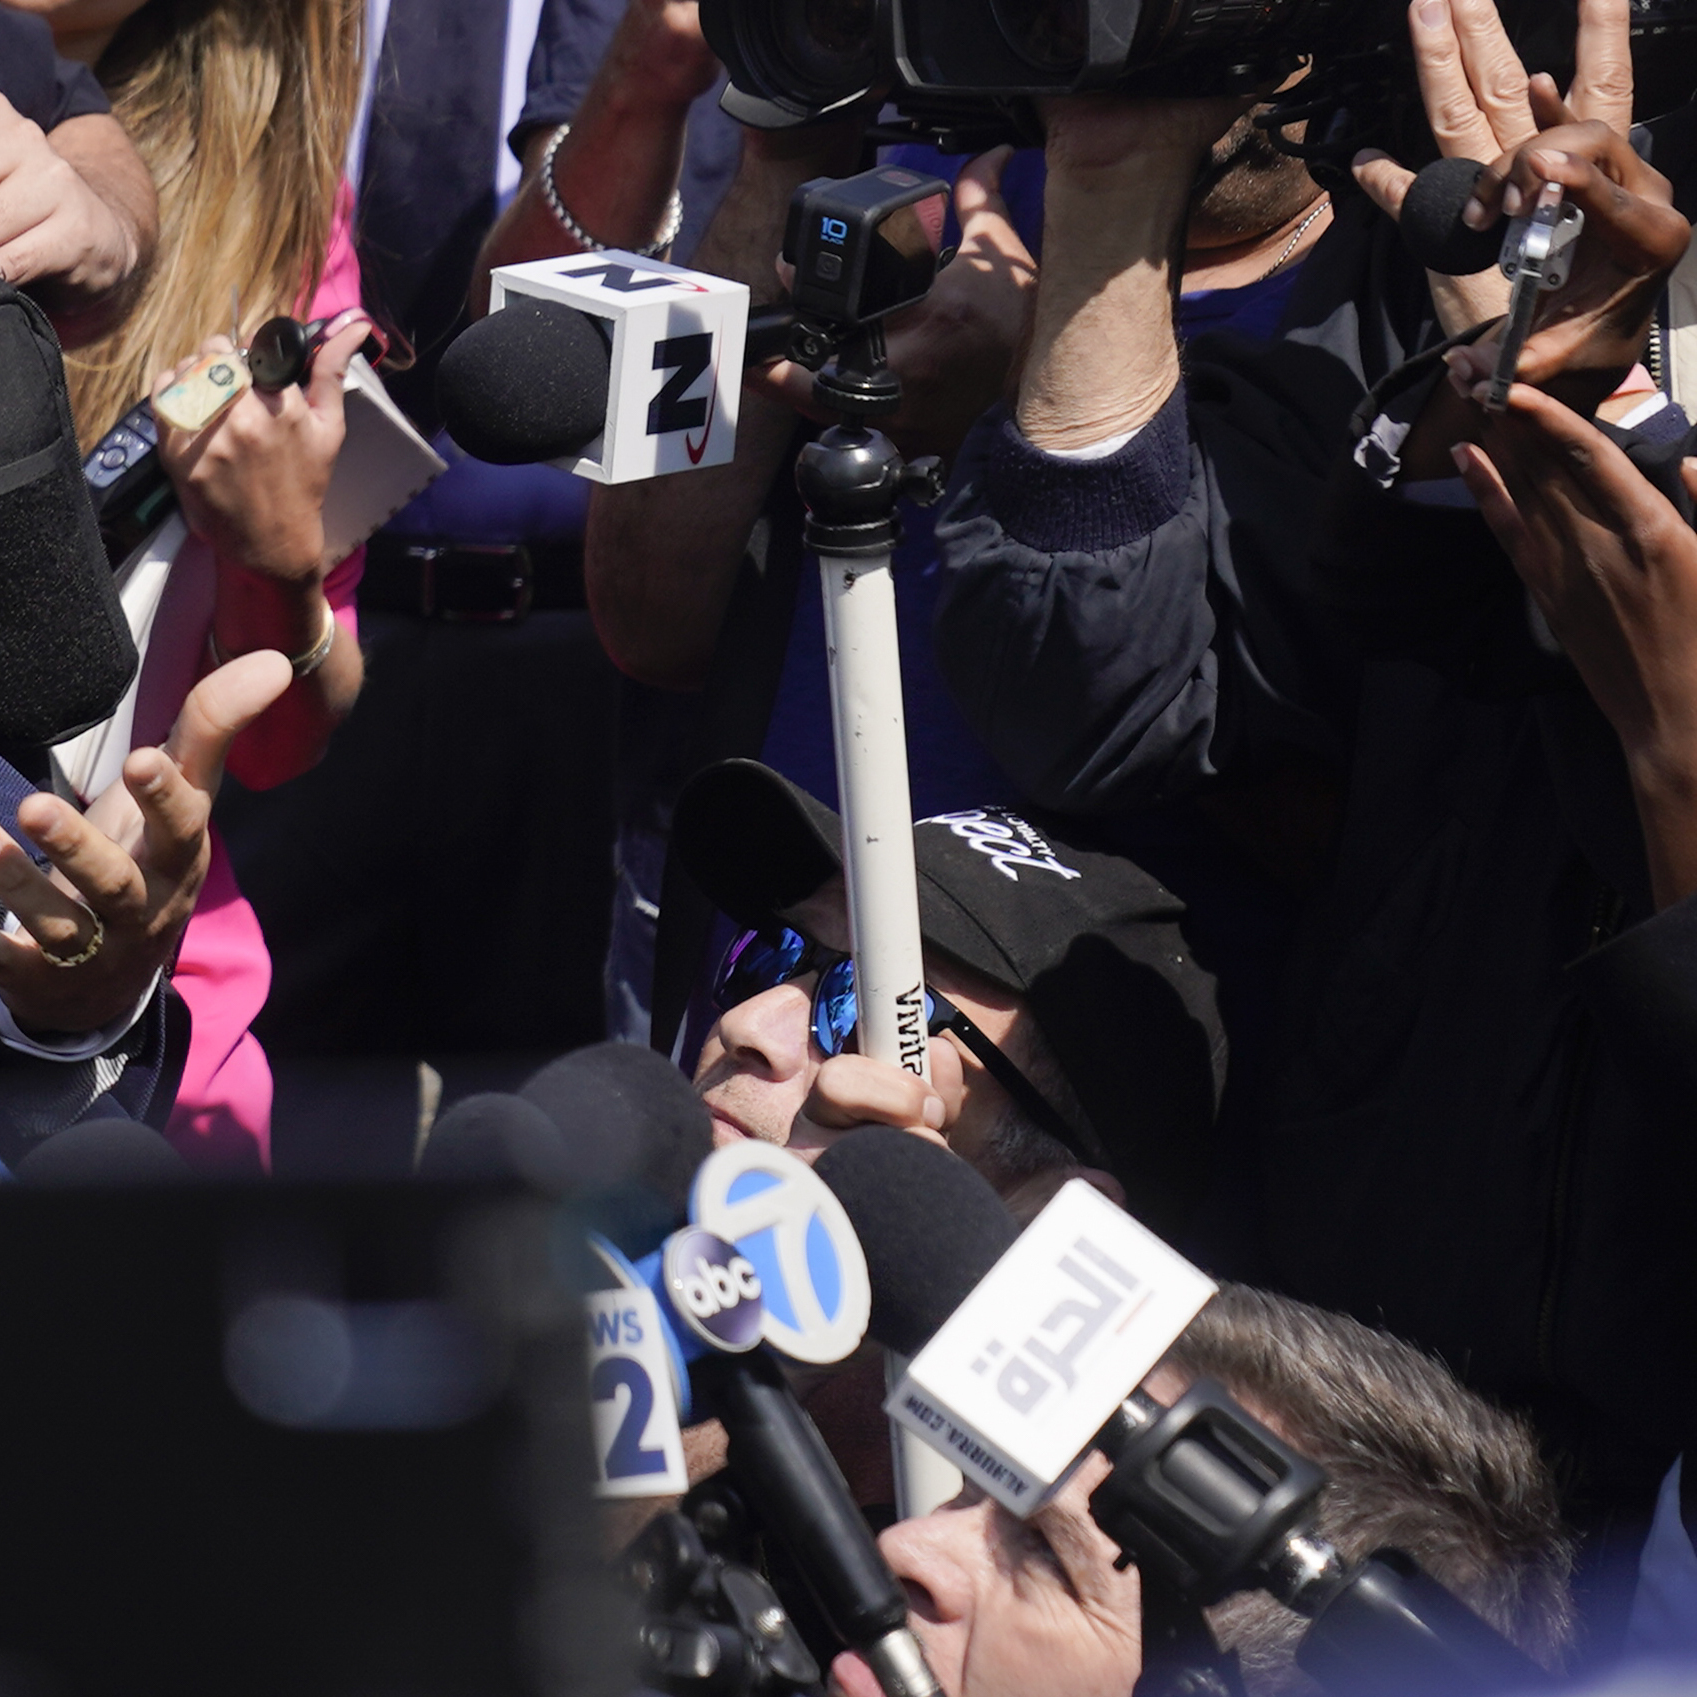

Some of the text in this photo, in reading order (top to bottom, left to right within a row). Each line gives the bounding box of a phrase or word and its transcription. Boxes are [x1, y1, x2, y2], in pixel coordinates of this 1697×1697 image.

[820, 216, 848, 240] 10
[686, 1256, 762, 1319] abc
[969, 1234, 1141, 1418] الحرة
[591, 1356, 669, 1480] 2
